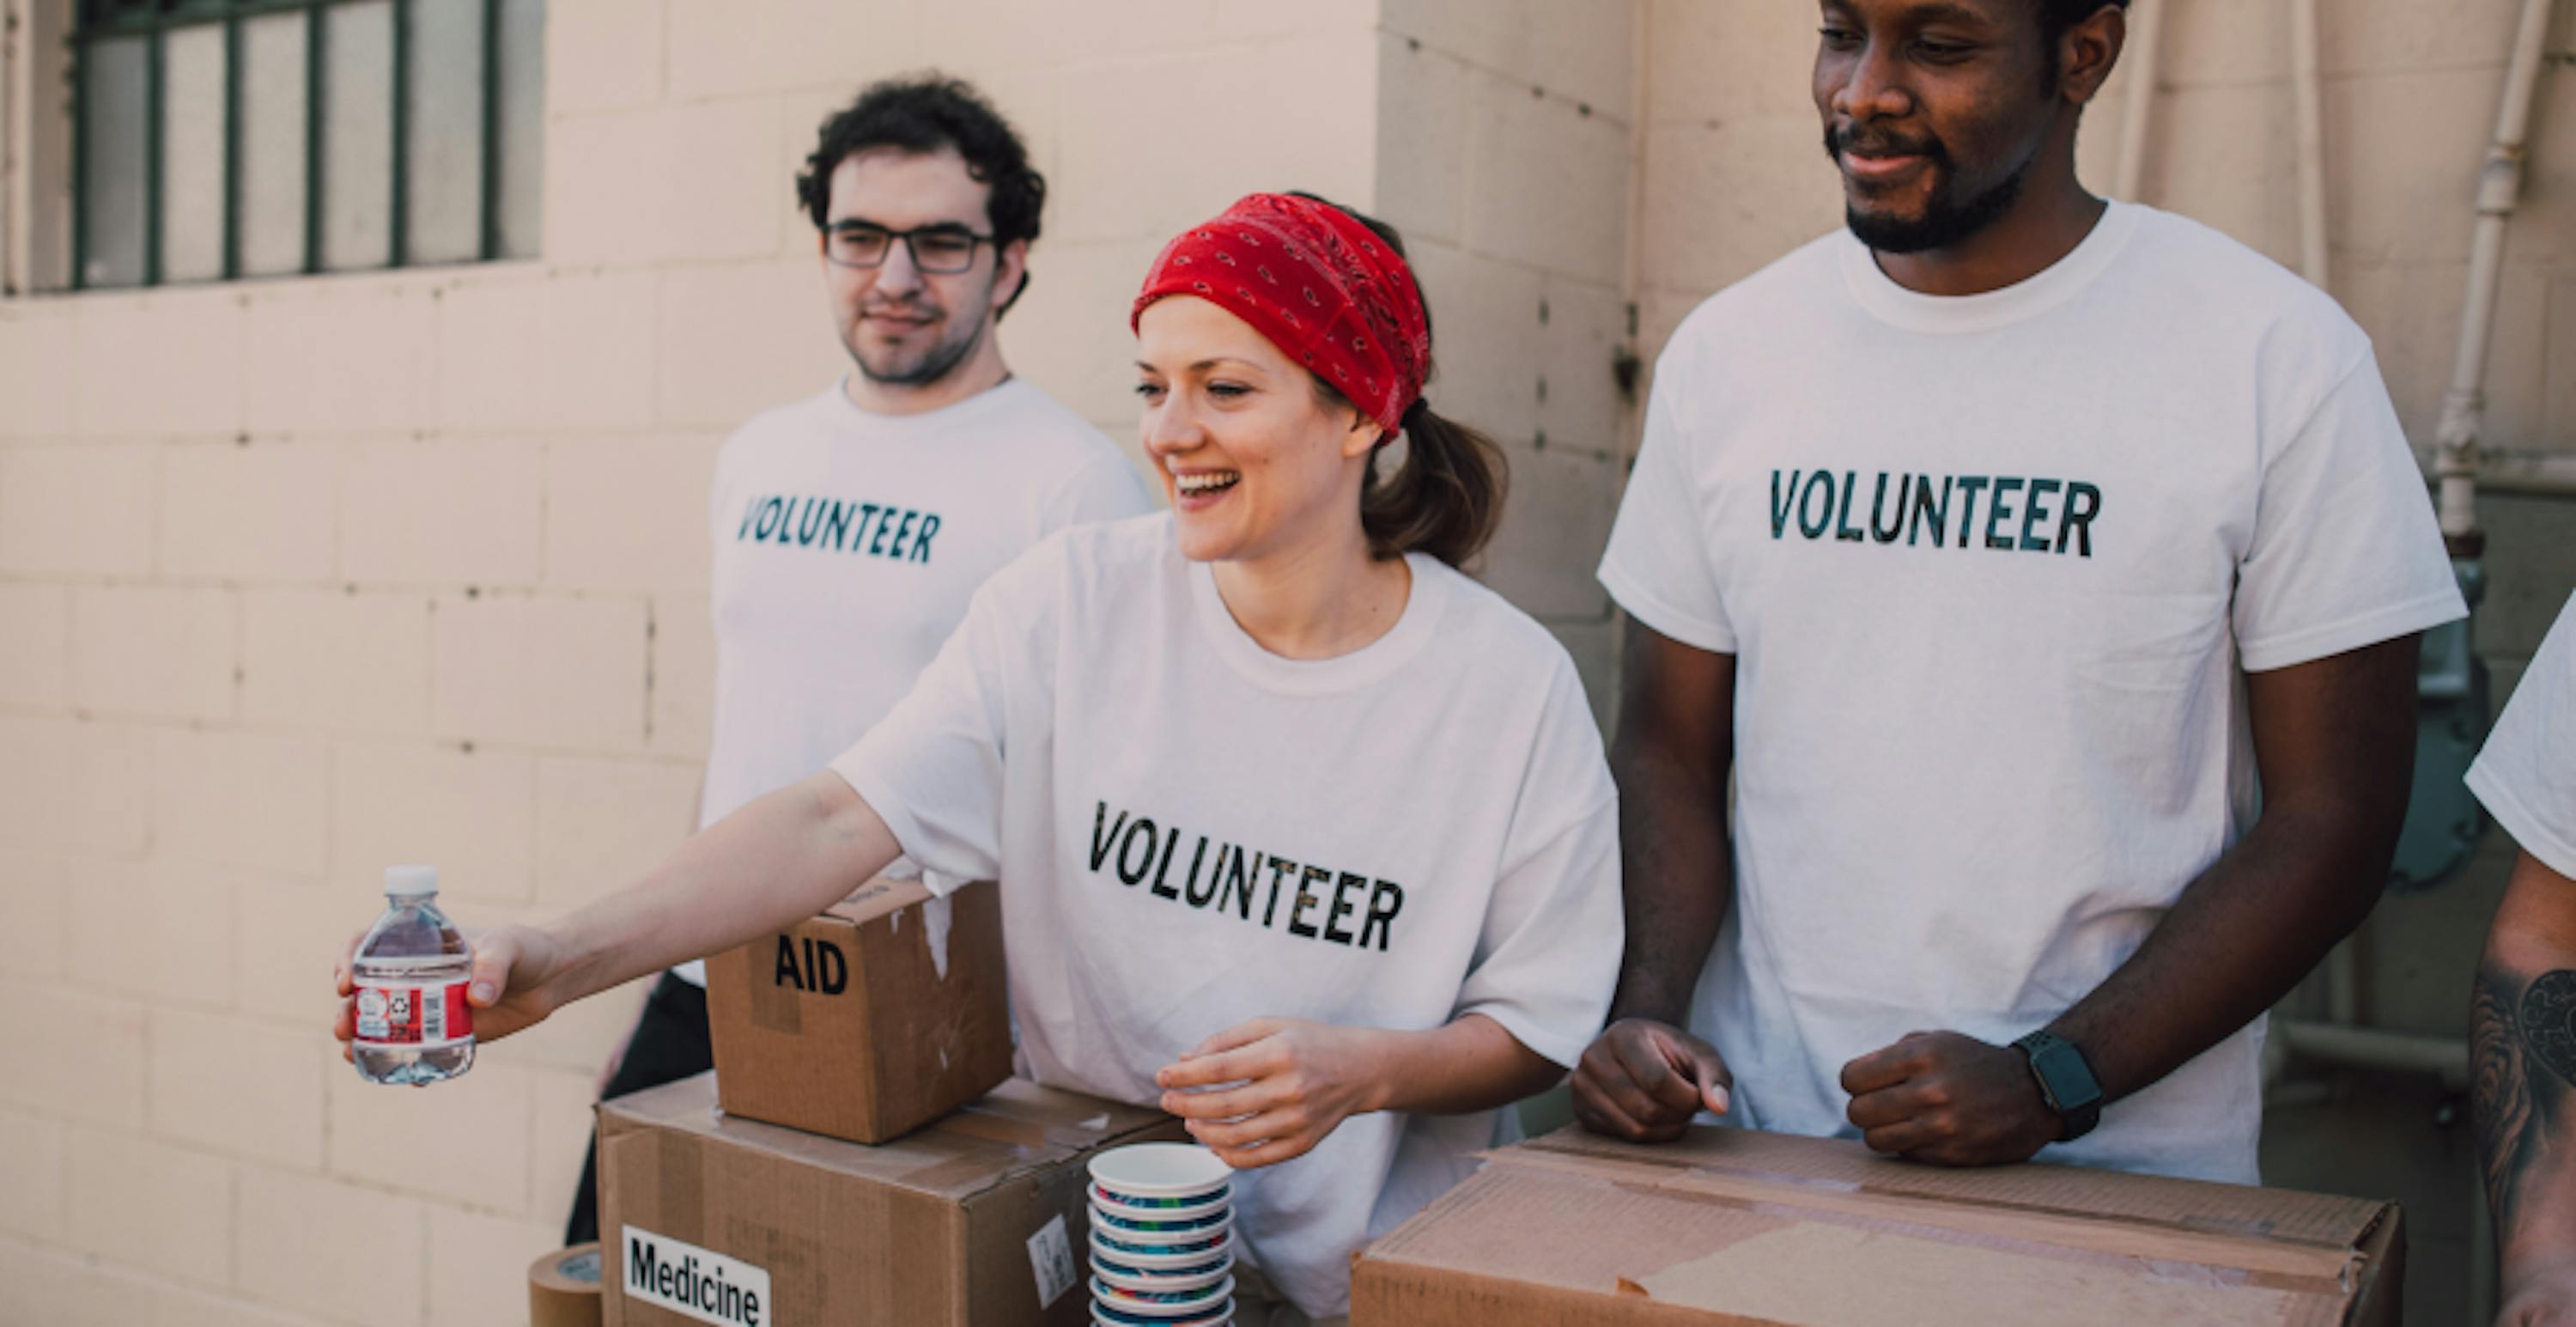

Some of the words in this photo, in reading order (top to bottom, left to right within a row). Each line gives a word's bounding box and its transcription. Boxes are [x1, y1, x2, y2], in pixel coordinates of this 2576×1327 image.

[738, 494, 941, 563] VOLUNTEER
[1771, 468, 2103, 558] VOLUNTEER
[1089, 800, 1405, 952] VOLUNTEER
[775, 934, 848, 995] AID
[631, 1237, 759, 1326] Medicine
